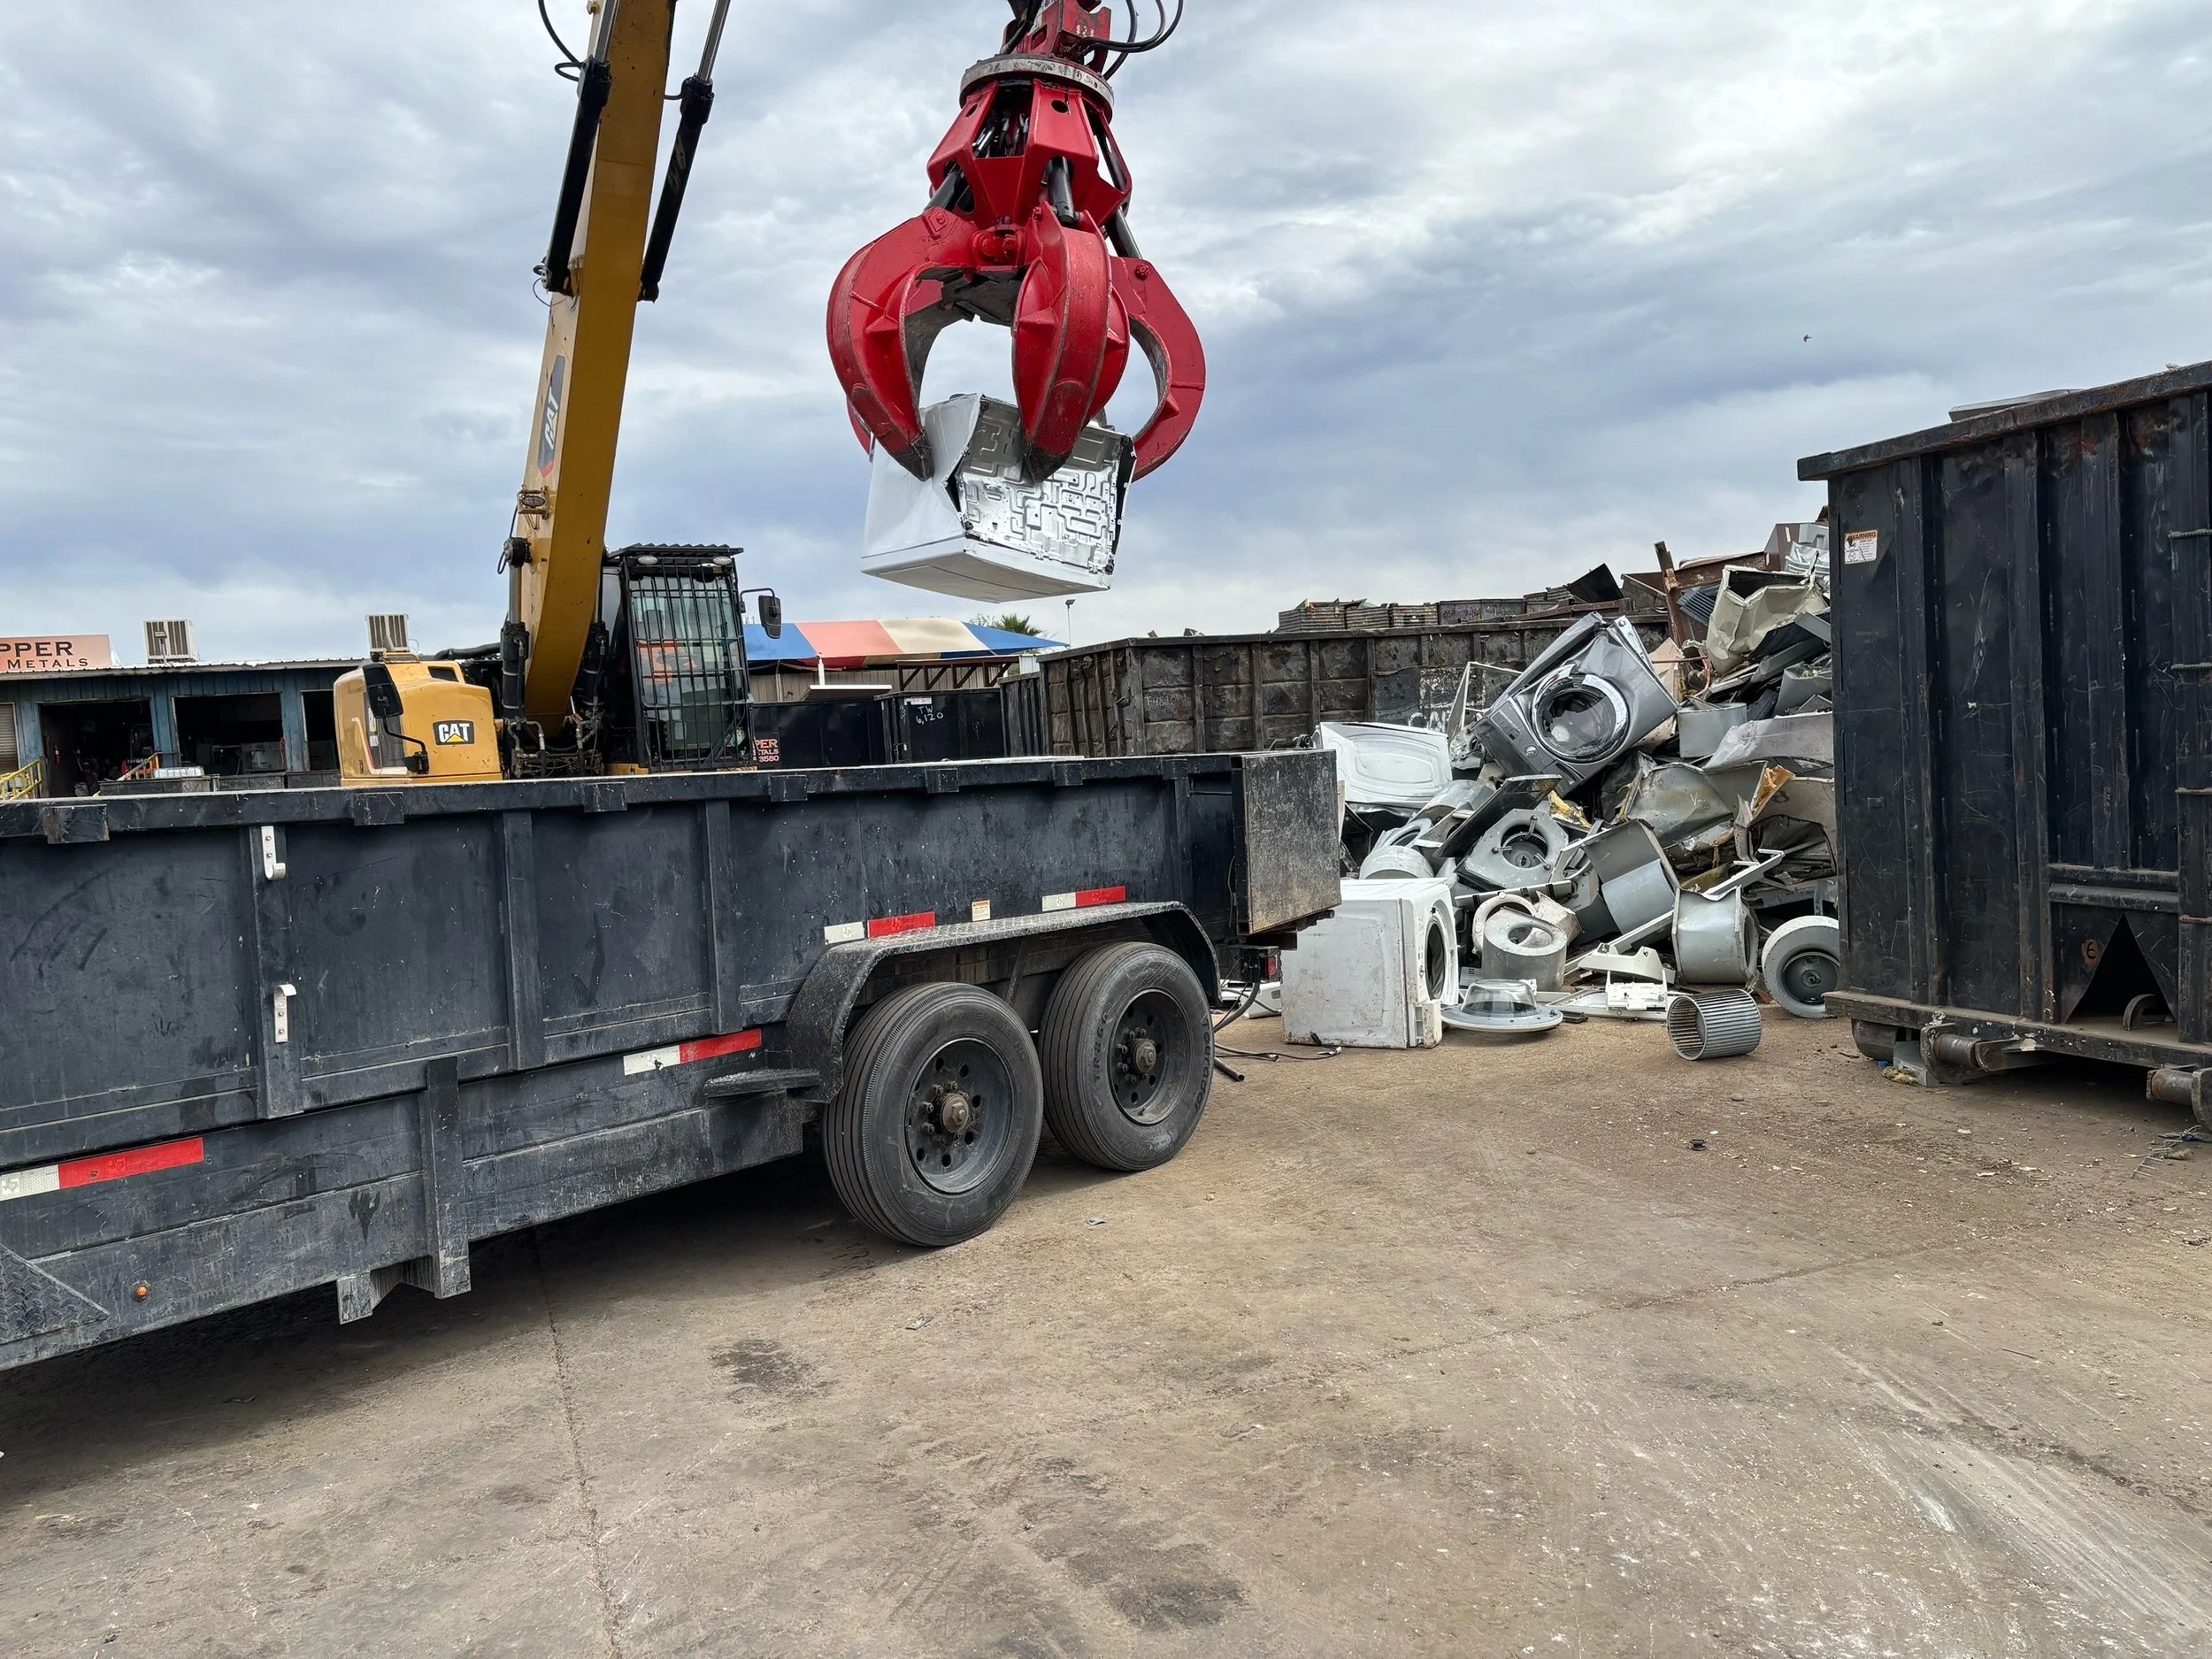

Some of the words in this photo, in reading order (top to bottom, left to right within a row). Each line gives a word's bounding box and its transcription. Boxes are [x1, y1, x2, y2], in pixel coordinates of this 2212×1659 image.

[543, 386, 559, 451] CAT
[0, 641, 73, 657] PPER
[7, 657, 88, 669] METALS
[438, 723, 470, 743] CAT
